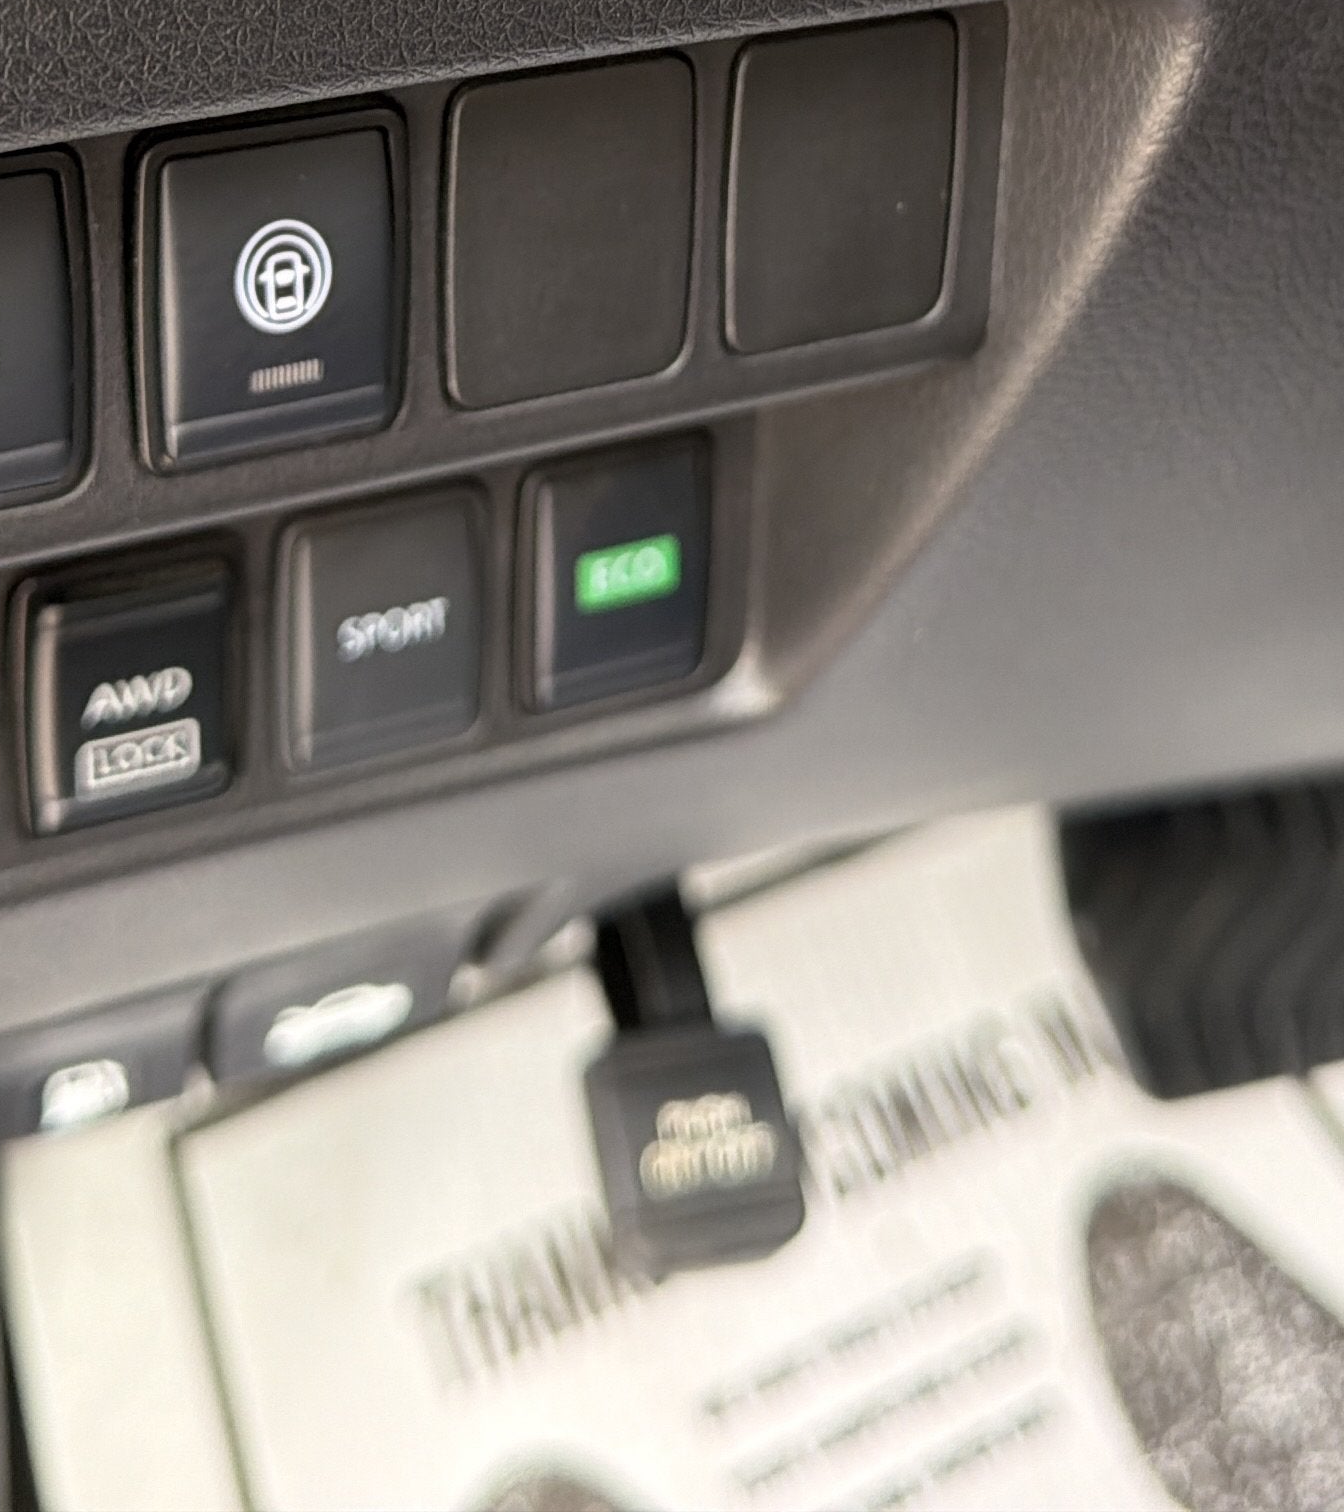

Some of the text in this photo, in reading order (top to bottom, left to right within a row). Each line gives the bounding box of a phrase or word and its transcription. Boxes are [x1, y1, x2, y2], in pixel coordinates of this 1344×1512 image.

[586, 544, 670, 596] ECO
[336, 595, 449, 663] SPORT
[80, 666, 194, 731] AWD
[94, 730, 188, 777] LOCK
